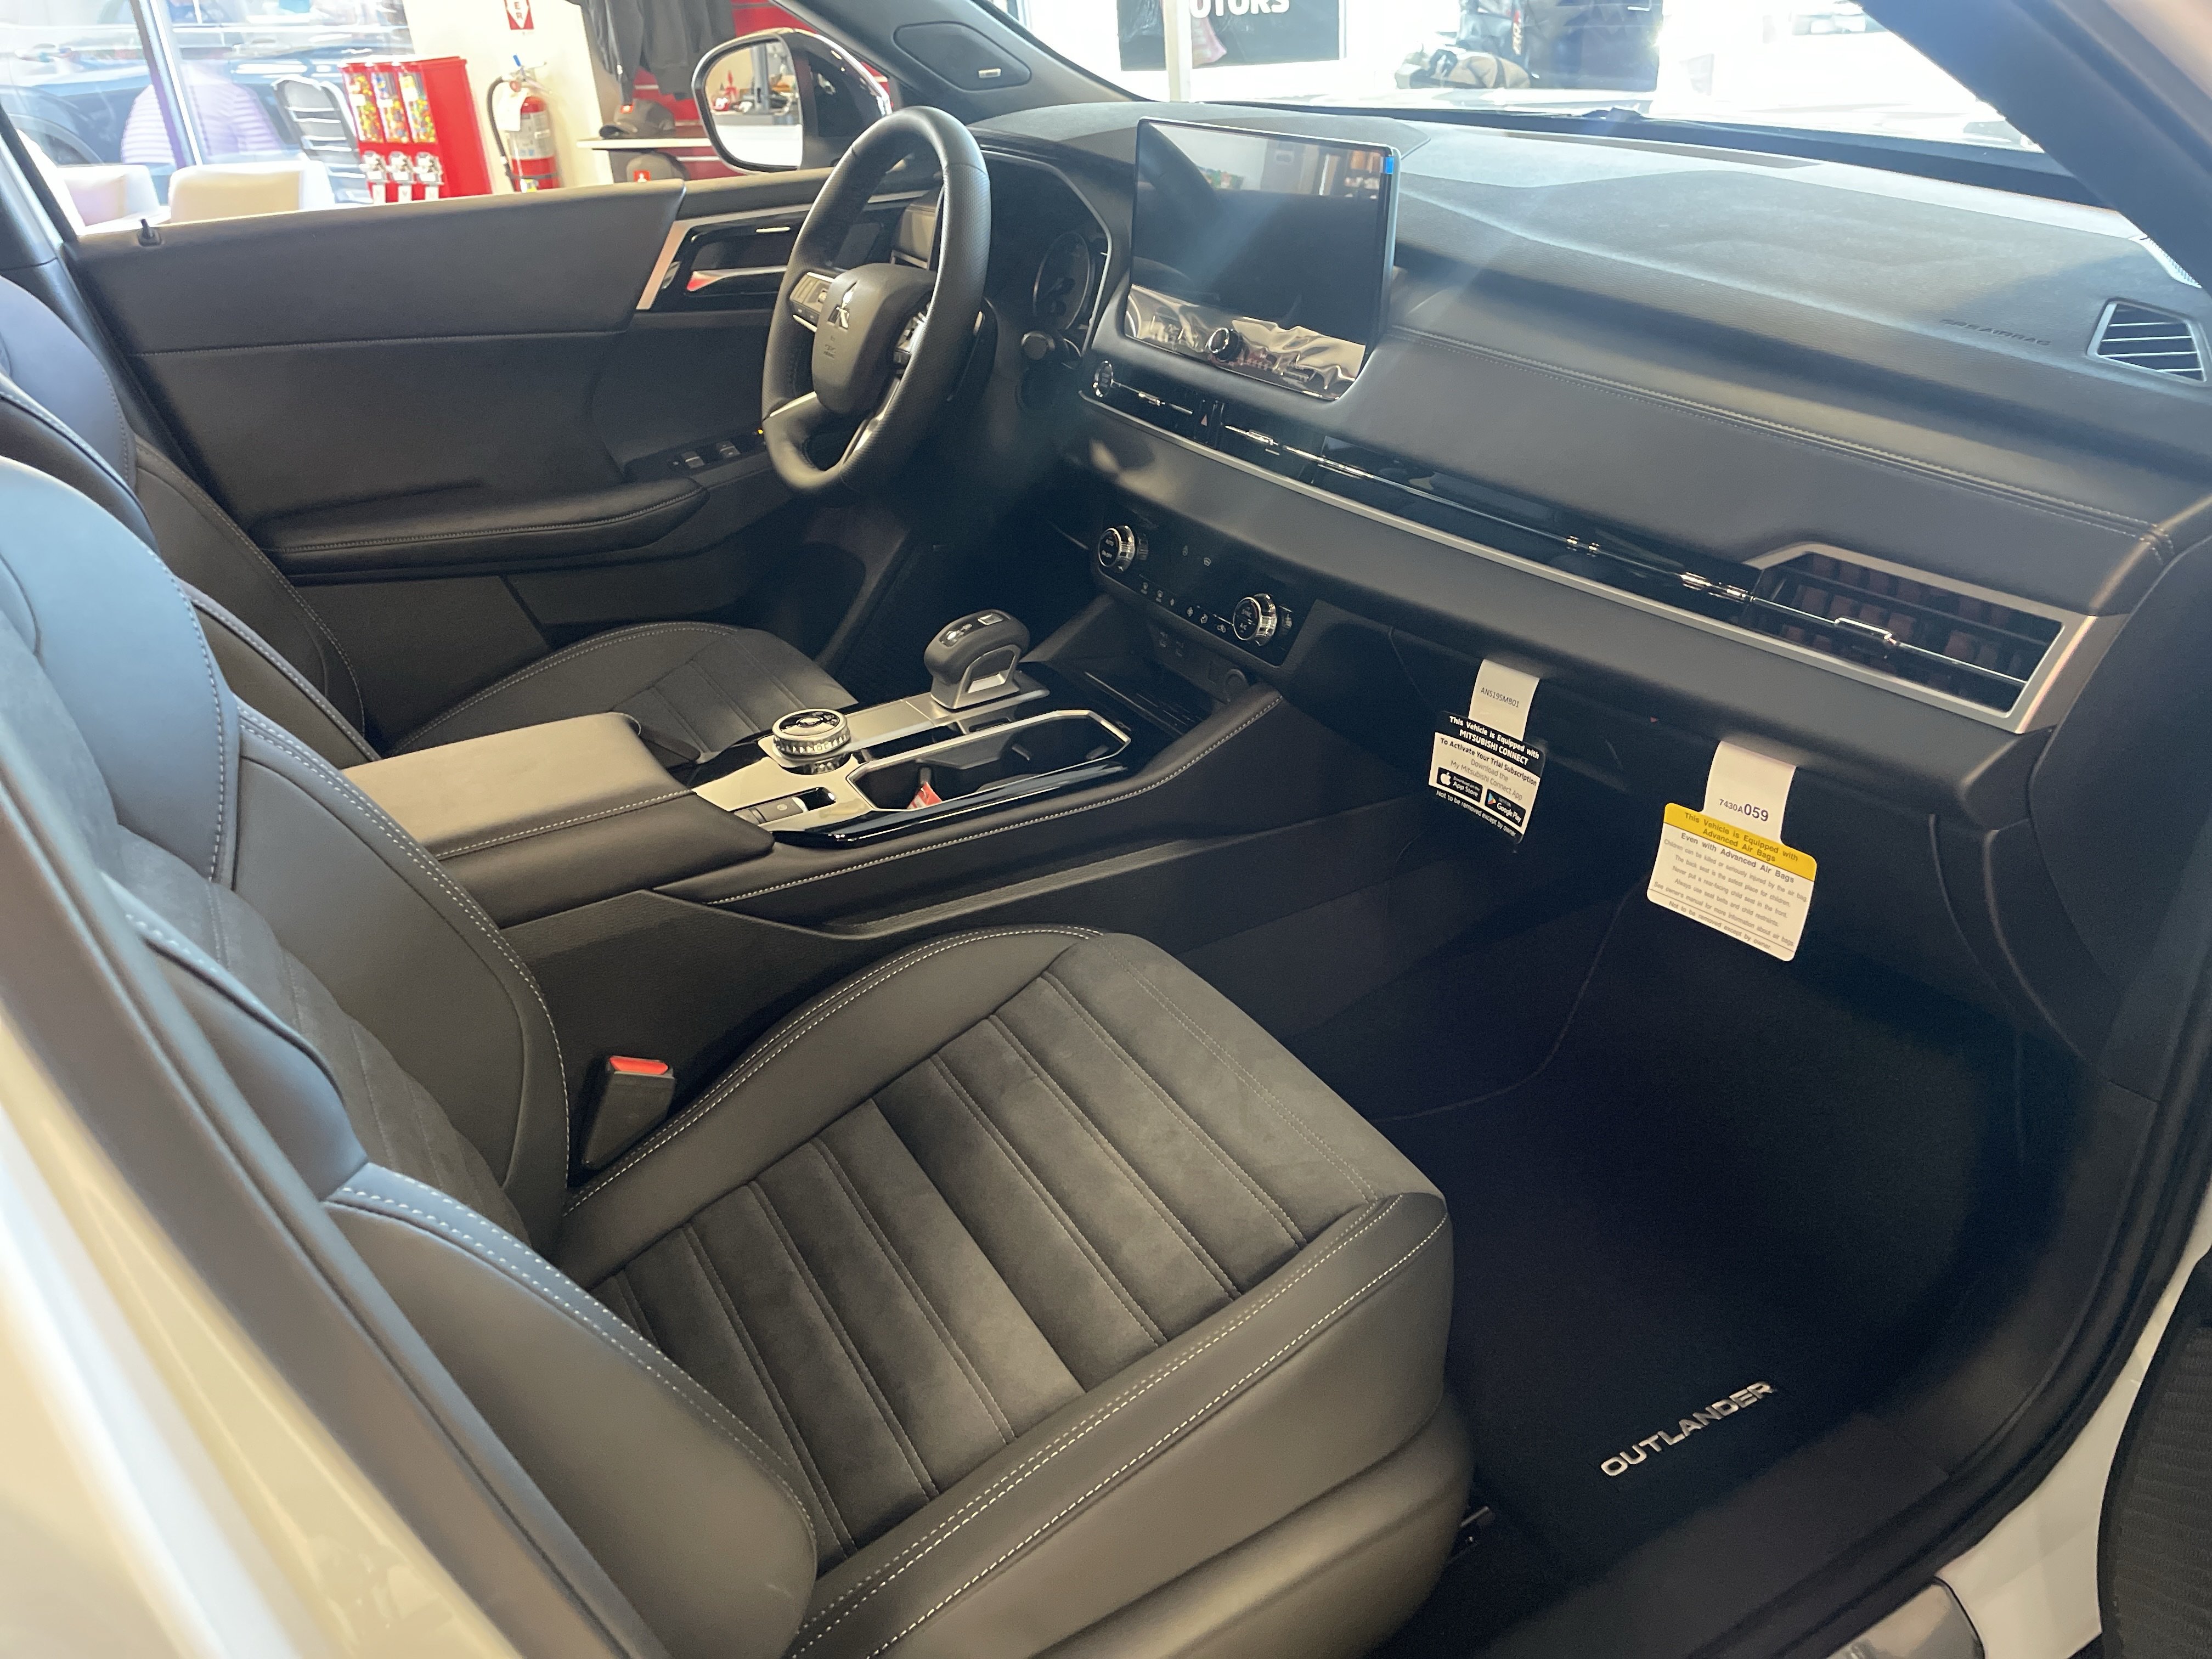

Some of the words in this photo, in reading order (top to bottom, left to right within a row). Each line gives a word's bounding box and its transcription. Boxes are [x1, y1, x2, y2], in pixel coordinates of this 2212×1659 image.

[1189, 0, 1290, 18] OTORS
[1449, 715, 1463, 726] This
[1466, 721, 1488, 736] Vehicle
[1497, 734, 1525, 752] Equipped
[1527, 748, 1539, 760] with
[1459, 729, 1498, 751] MITSUBISHI
[1499, 746, 1529, 765] CONNECT
[1449, 741, 1475, 756] Activate
[1476, 751, 1489, 761] Your
[1491, 757, 1503, 768] Trial
[1504, 764, 1537, 787] Subscription
[1451, 760, 1459, 769] My
[1461, 764, 1489, 783] Mitsubishi
[1490, 777, 1511, 794] Connect
[1512, 790, 1522, 800] App
[1471, 759, 1499, 777] Download
[1499, 772, 1509, 781] the
[1436, 790, 1447, 799] Not
[1453, 781, 1465, 791] App
[1465, 786, 1479, 797] Store
[1497, 802, 1513, 817] Google
[1685, 812, 1700, 823] This
[1703, 819, 1730, 834] Vehicle
[1733, 830, 1740, 839] is
[1743, 834, 1779, 854] Equipped
[1782, 850, 1798, 862] with
[1703, 828, 1739, 847] Advanced
[1742, 843, 1753, 853] Air
[1757, 849, 1776, 862] Bags
[1681, 833, 1698, 845] Even
[1702, 841, 1717, 853] with
[1720, 849, 1757, 867] Advanced
[1760, 864, 1772, 873] Air
[1775, 870, 1795, 883] Bags
[1601, 1380, 1774, 1476] OUTLANDER
